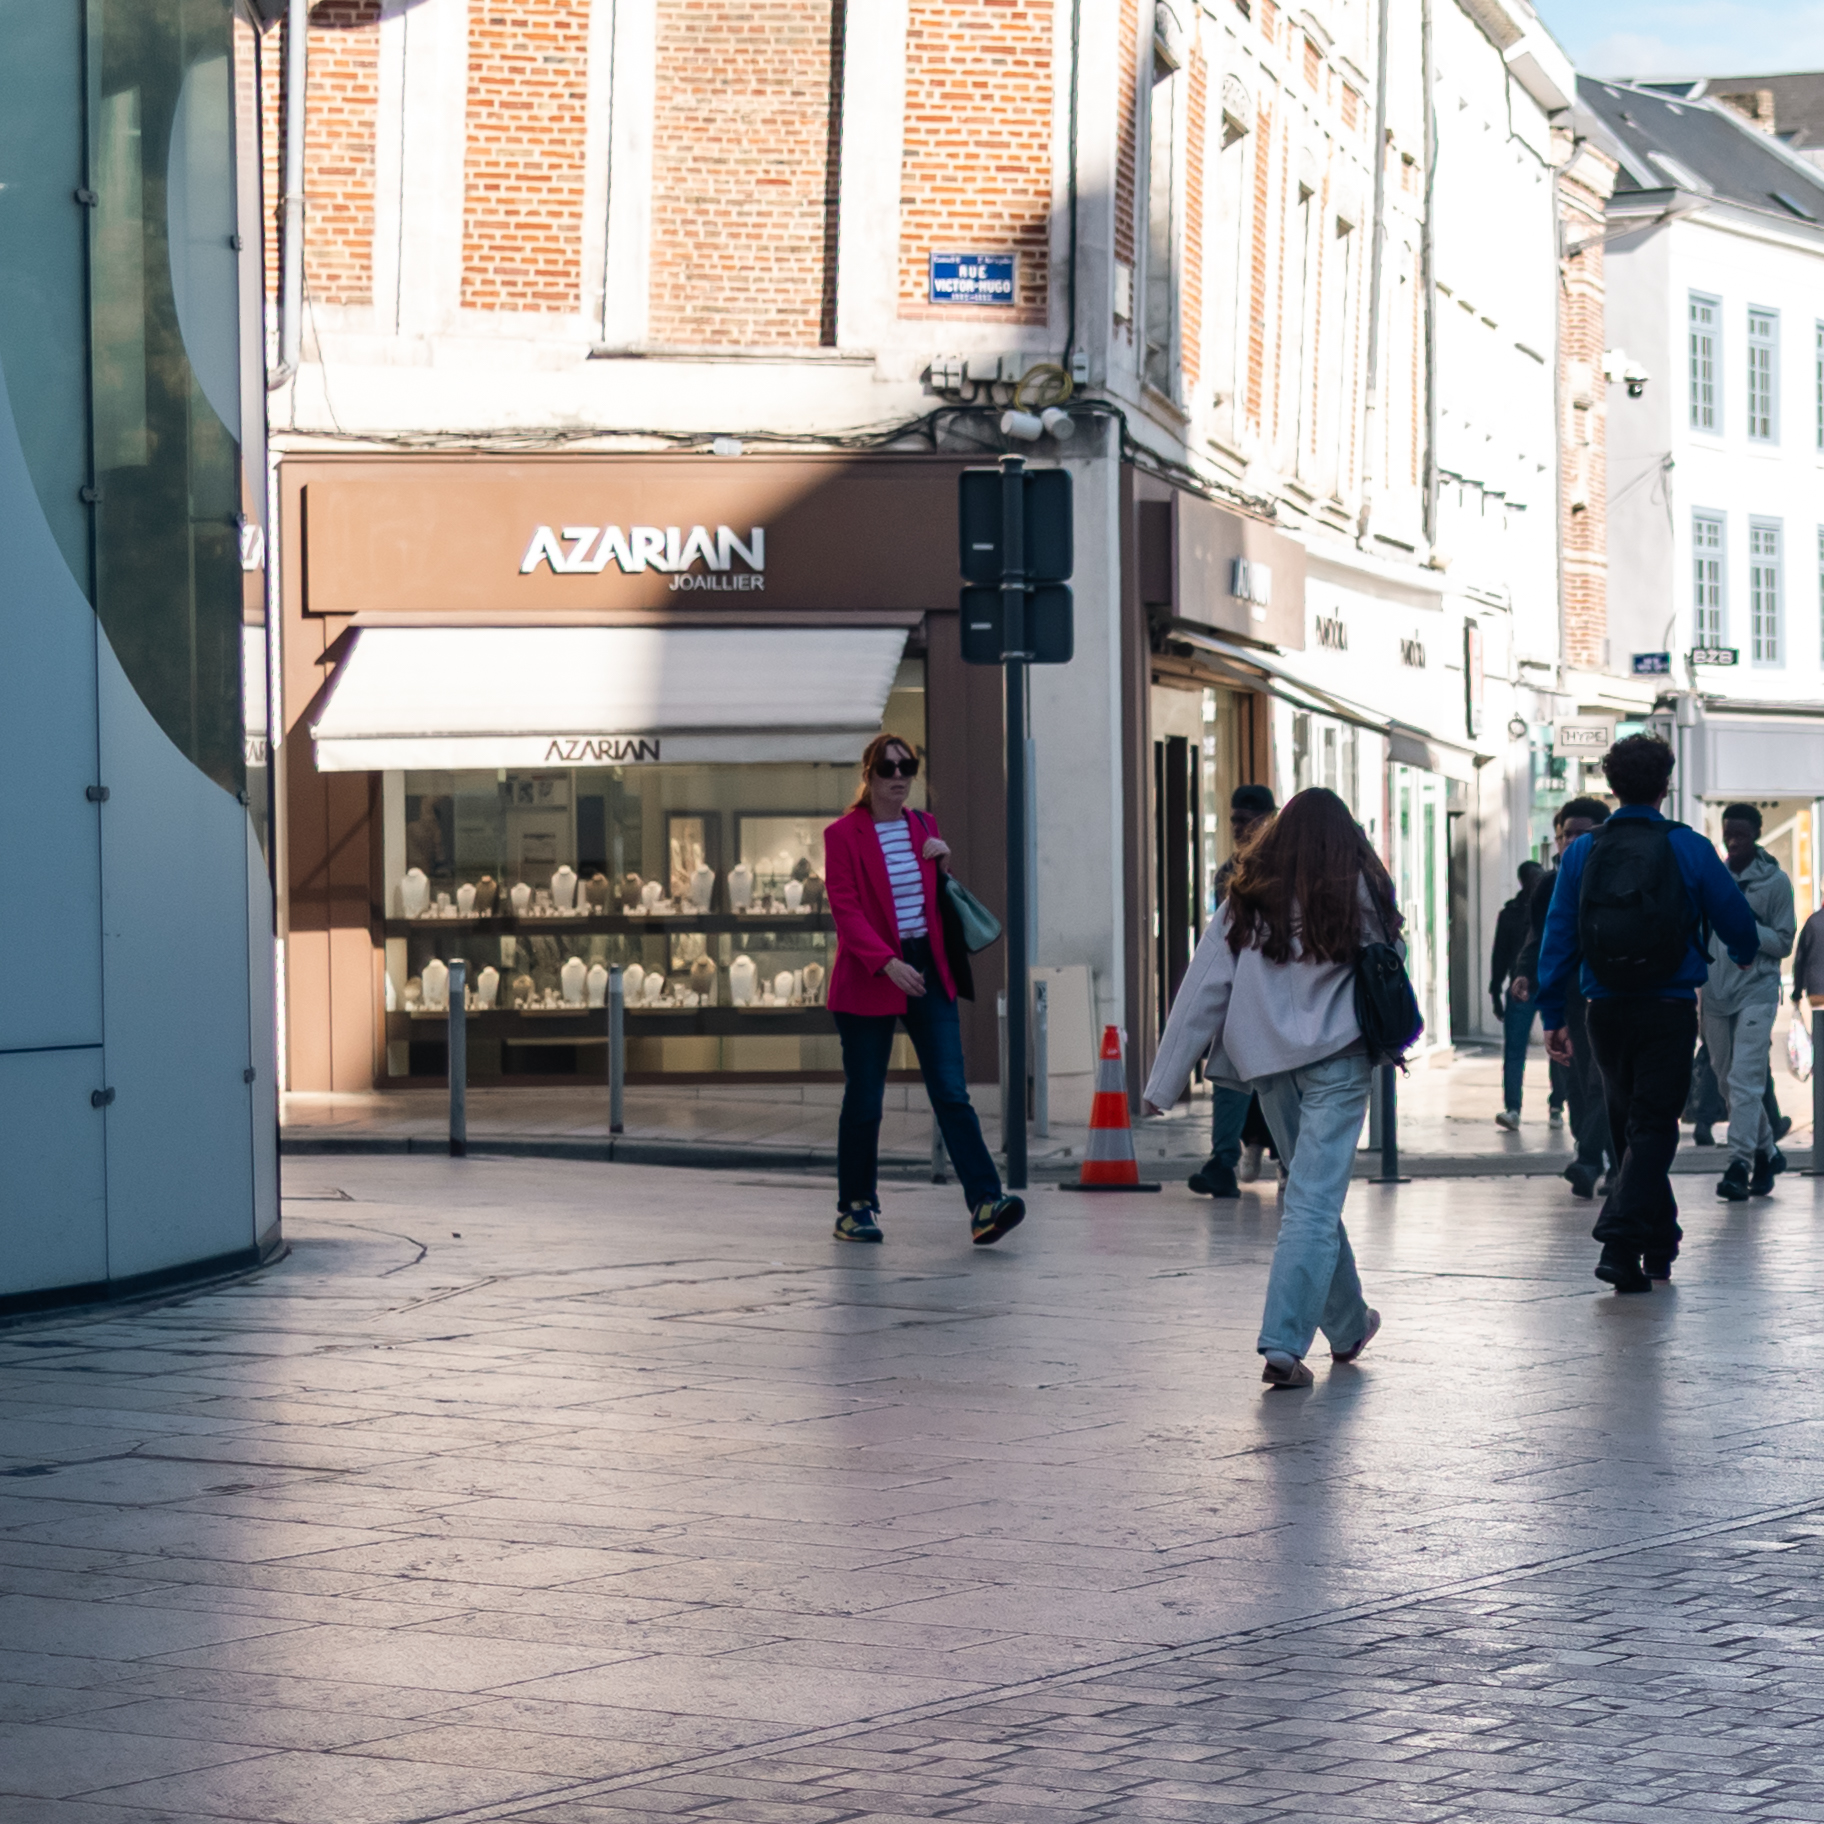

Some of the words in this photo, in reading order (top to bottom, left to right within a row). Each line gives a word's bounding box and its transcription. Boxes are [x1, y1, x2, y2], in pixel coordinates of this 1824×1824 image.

[958, 264, 987, 278] RUE
[519, 525, 765, 574] AZARIAN
[669, 573, 765, 591] JOAILLIER
[1693, 649, 1733, 664] BZB
[1566, 730, 1605, 742] HYPE
[544, 740, 660, 761] AZARIAN
